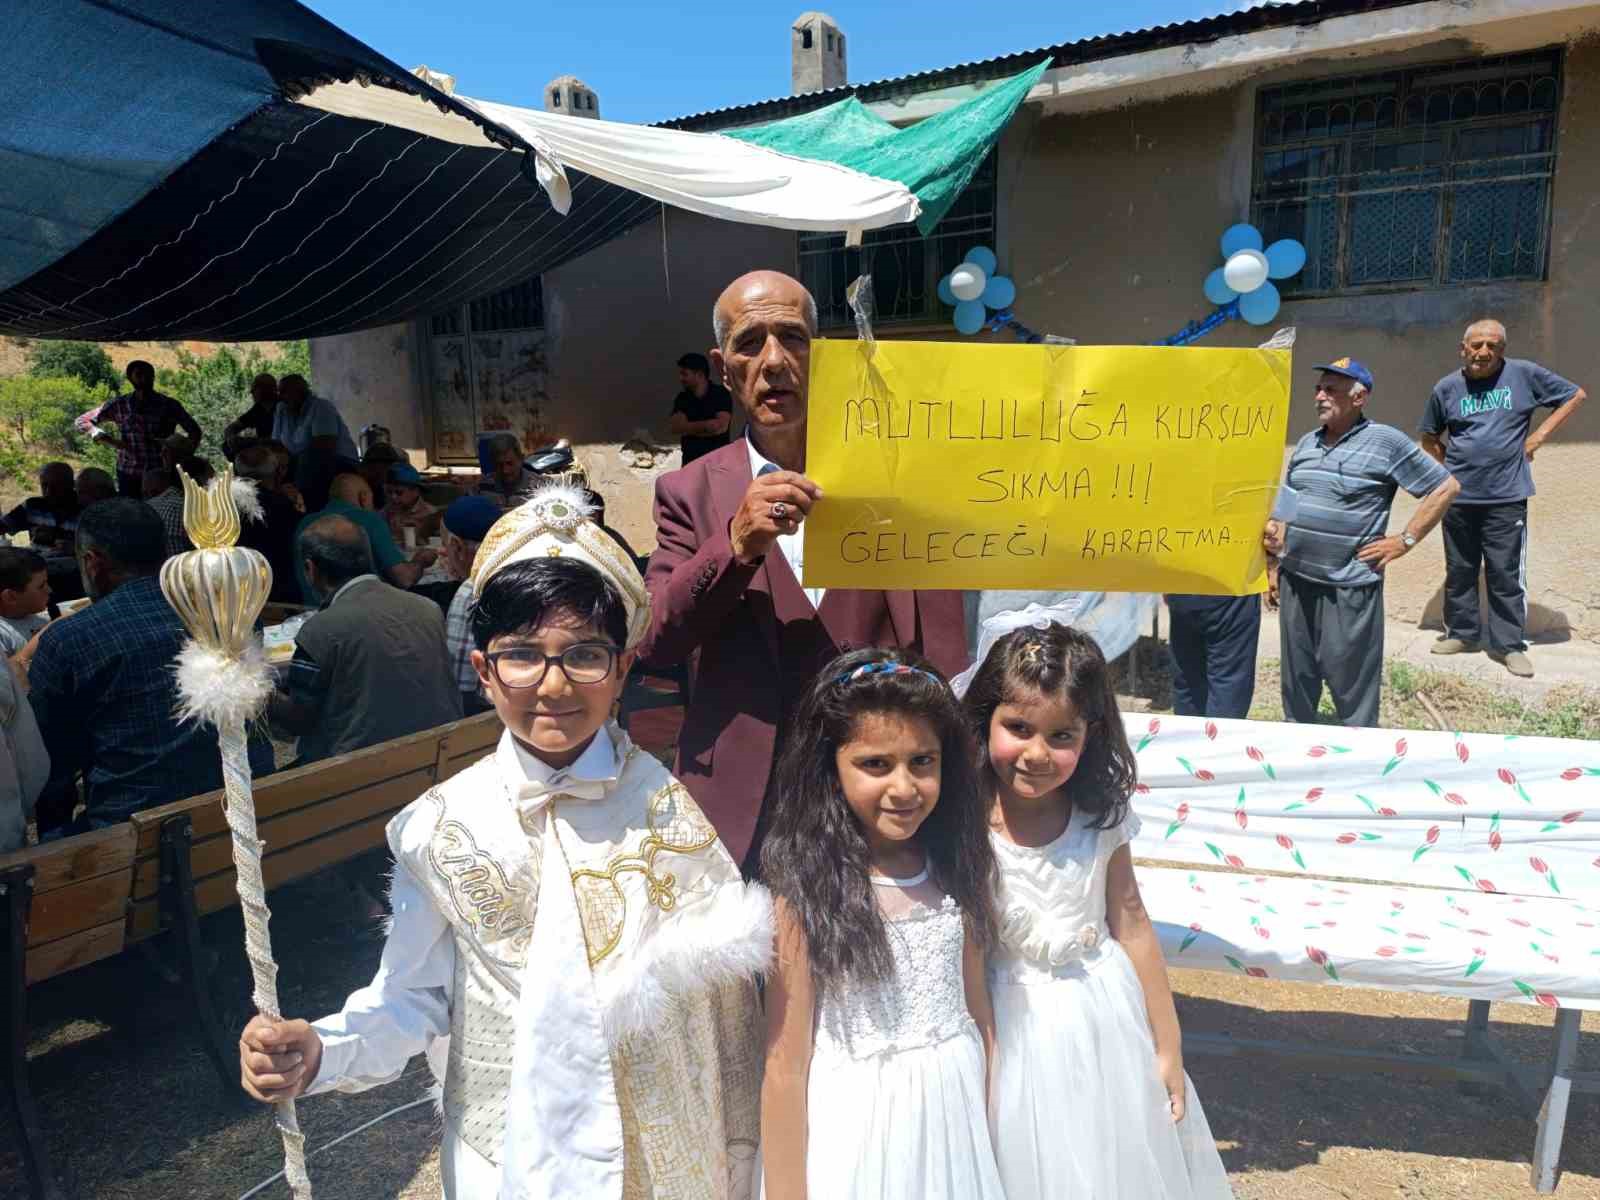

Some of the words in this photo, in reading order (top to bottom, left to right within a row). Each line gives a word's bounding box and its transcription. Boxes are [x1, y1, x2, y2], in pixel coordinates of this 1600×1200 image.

[845, 390, 1130, 442] MUTLULUĞA
[1156, 402, 1274, 442] KURŞUN
[968, 467, 1091, 503] SIKMA
[840, 524, 1049, 563] GELECEĞİ
